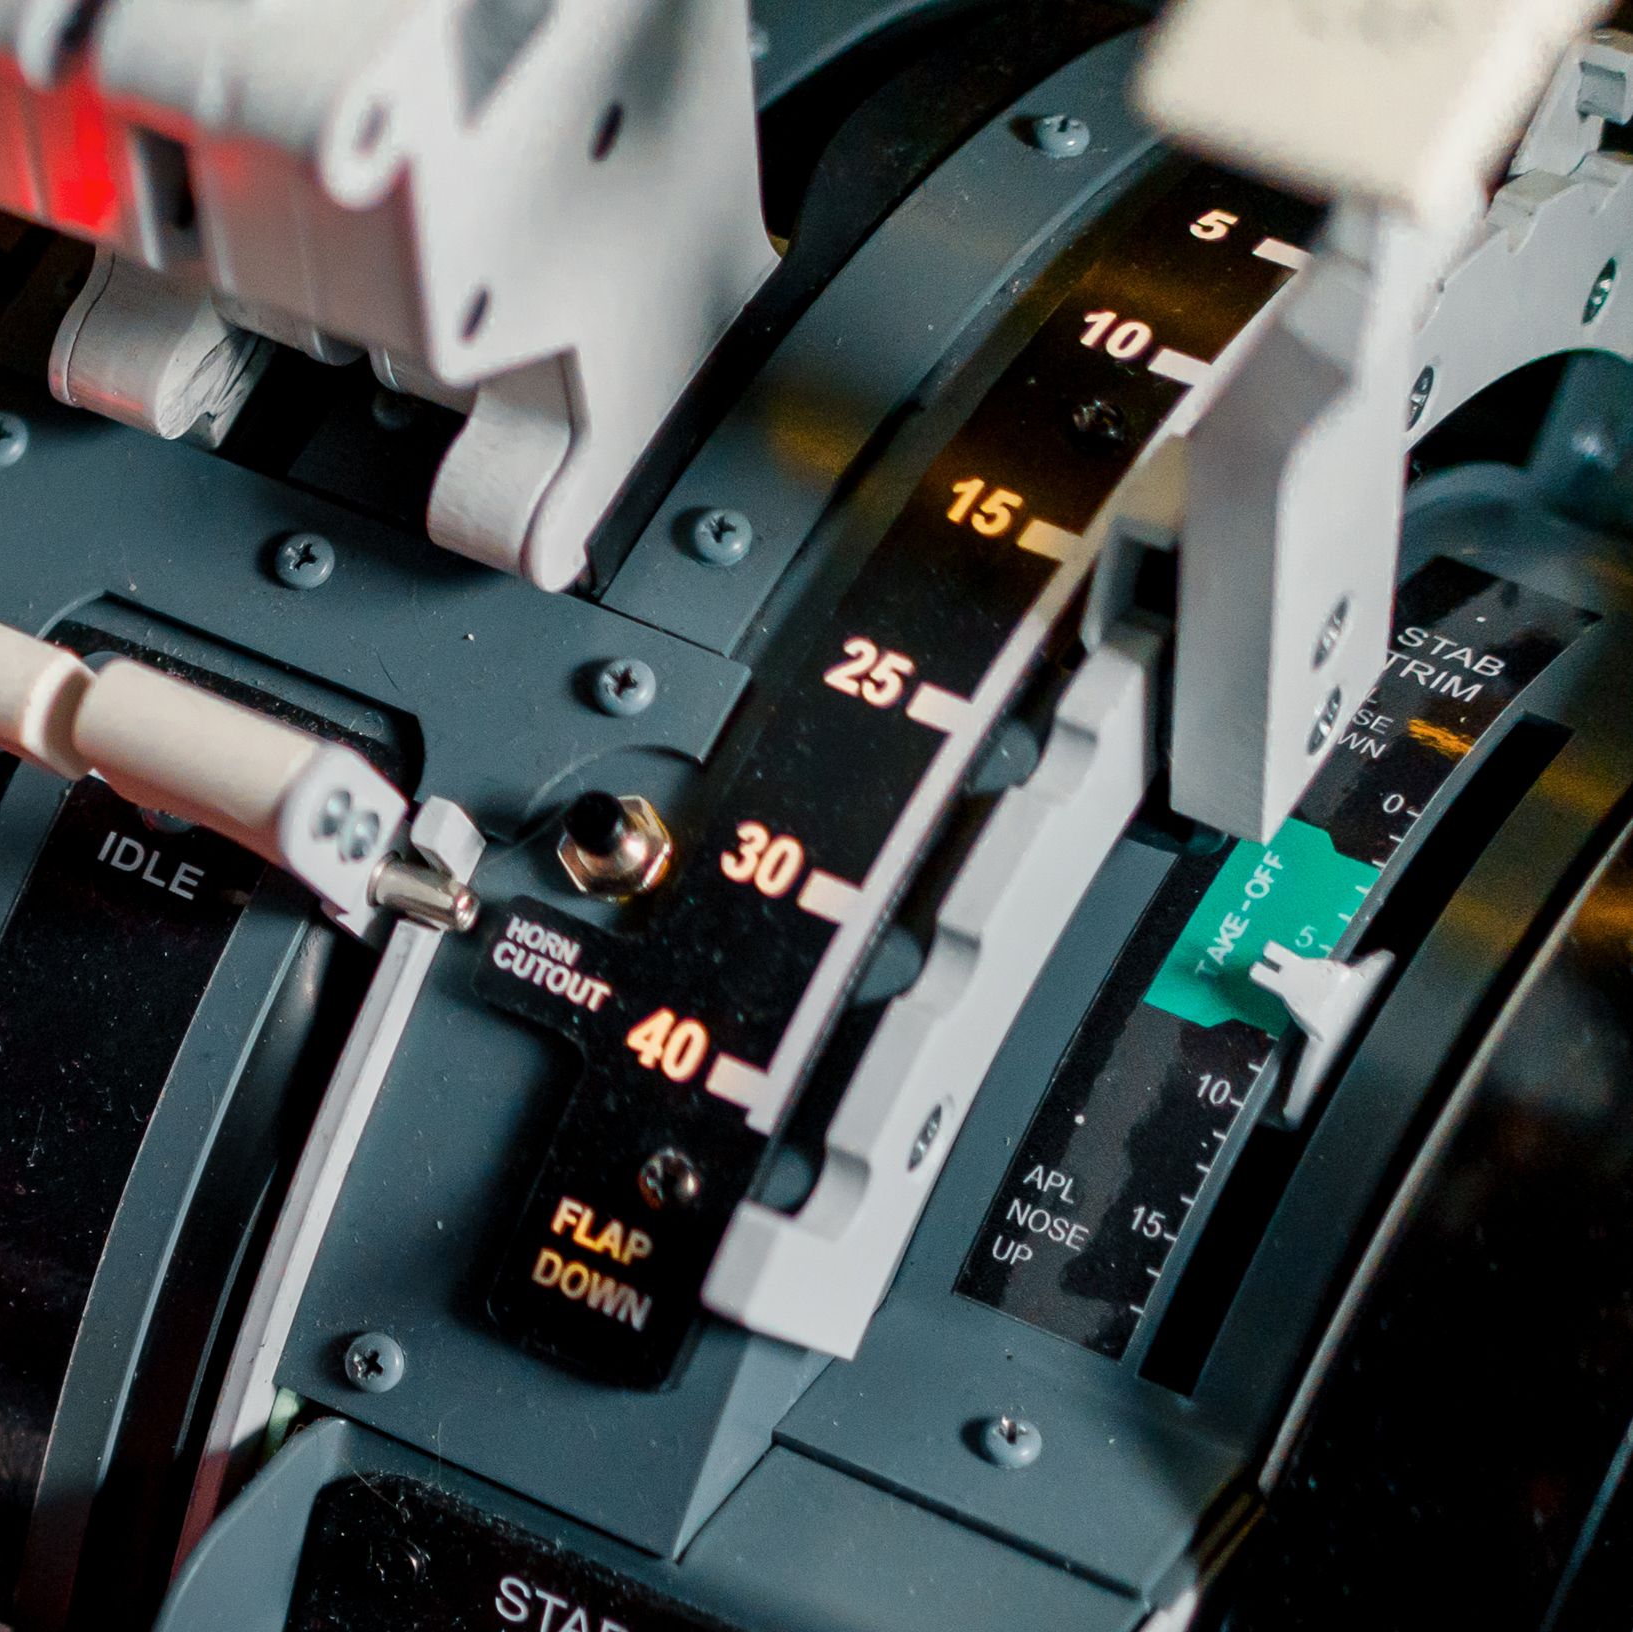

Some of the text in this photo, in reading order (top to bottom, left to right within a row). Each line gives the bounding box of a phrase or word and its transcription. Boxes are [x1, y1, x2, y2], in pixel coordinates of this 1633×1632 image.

[1189, 209, 1239, 242] 5
[1080, 310, 1153, 361] 10
[947, 478, 1023, 536] 15
[823, 637, 916, 708] 25
[1385, 651, 1484, 703] TRIM
[1396, 627, 1506, 677] STAB
[1352, 709, 1394, 735] SE
[1383, 793, 1404, 814] 0
[97, 830, 205, 900] IDLE
[720, 822, 804, 898] 30
[1194, 850, 1285, 976] TAKE-OFF
[1294, 925, 1317, 948] 5
[505, 914, 581, 967] HORN
[492, 940, 611, 1012] CUTOUT
[626, 1008, 709, 1082] 40
[1196, 1074, 1231, 1105] 10
[1023, 1164, 1075, 1204] APL
[551, 1197, 653, 1265] FLAP
[1006, 1198, 1090, 1251] NOSE
[1130, 1204, 1167, 1239] 15
[991, 1234, 1033, 1266] UP
[531, 1248, 652, 1331] DOWN
